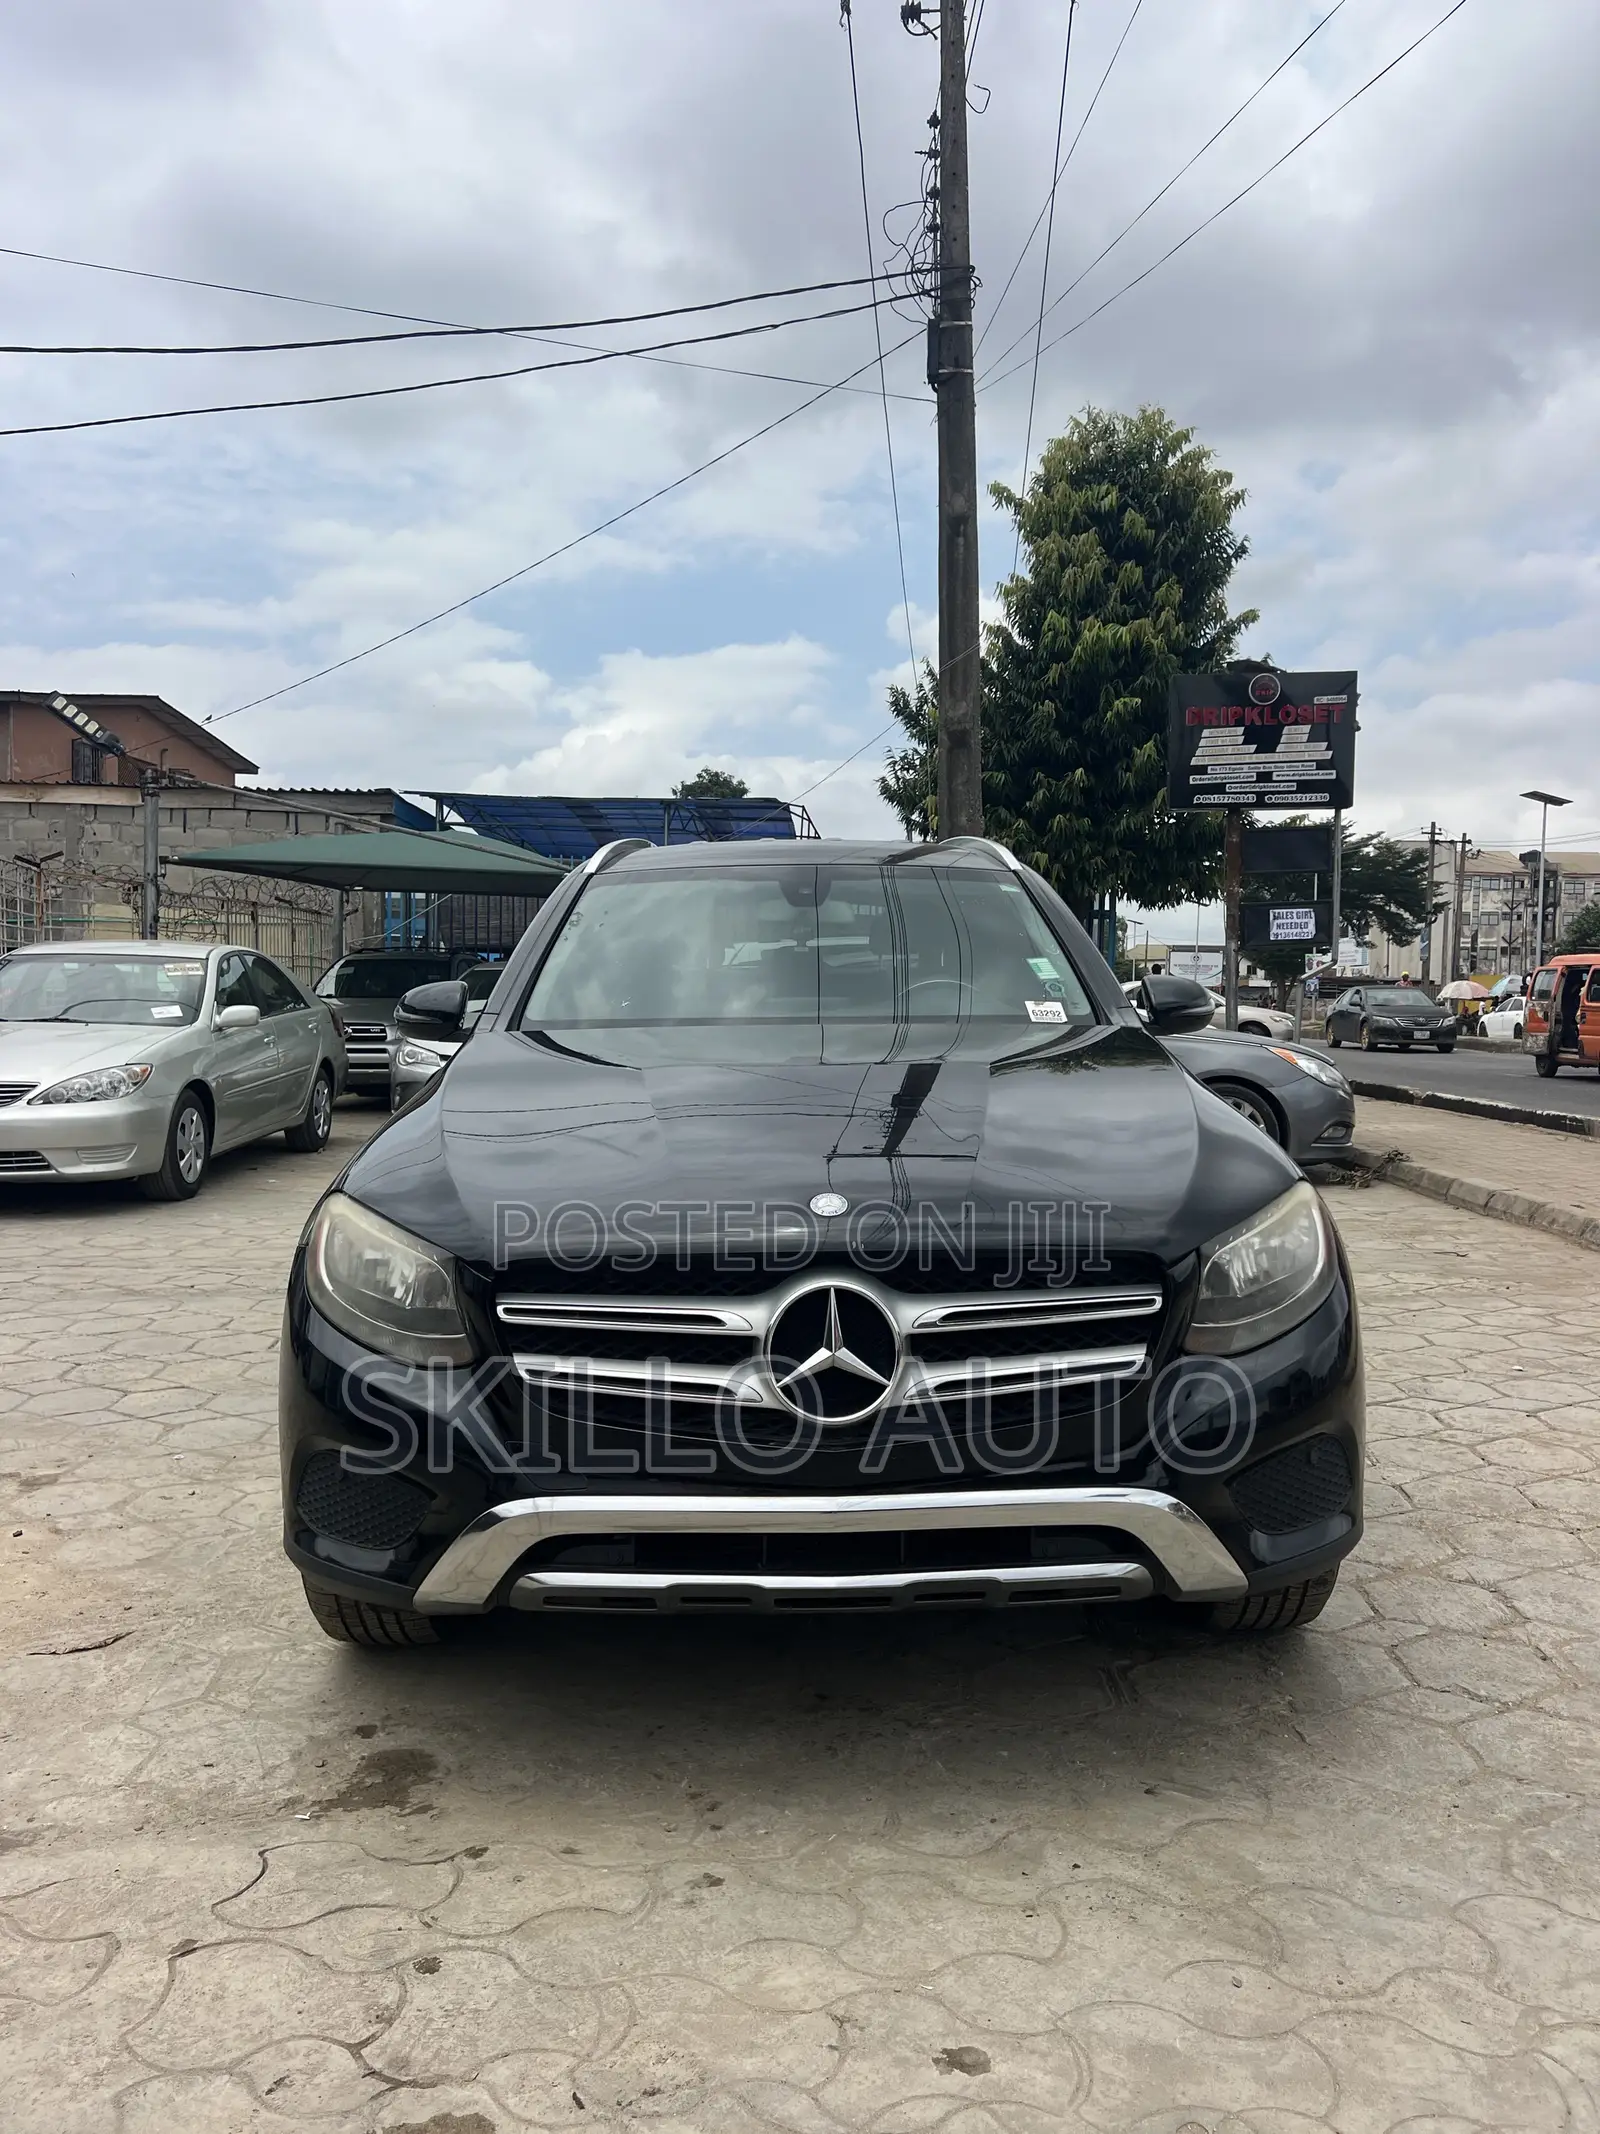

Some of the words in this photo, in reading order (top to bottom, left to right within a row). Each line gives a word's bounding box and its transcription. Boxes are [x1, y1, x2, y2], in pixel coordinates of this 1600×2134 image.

[1185, 704, 1346, 726] DRIPKLOSET
[1272, 911, 1295, 920] SALES
[1295, 911, 1314, 920] GIRL
[1031, 1009, 1062, 1018] 63292
